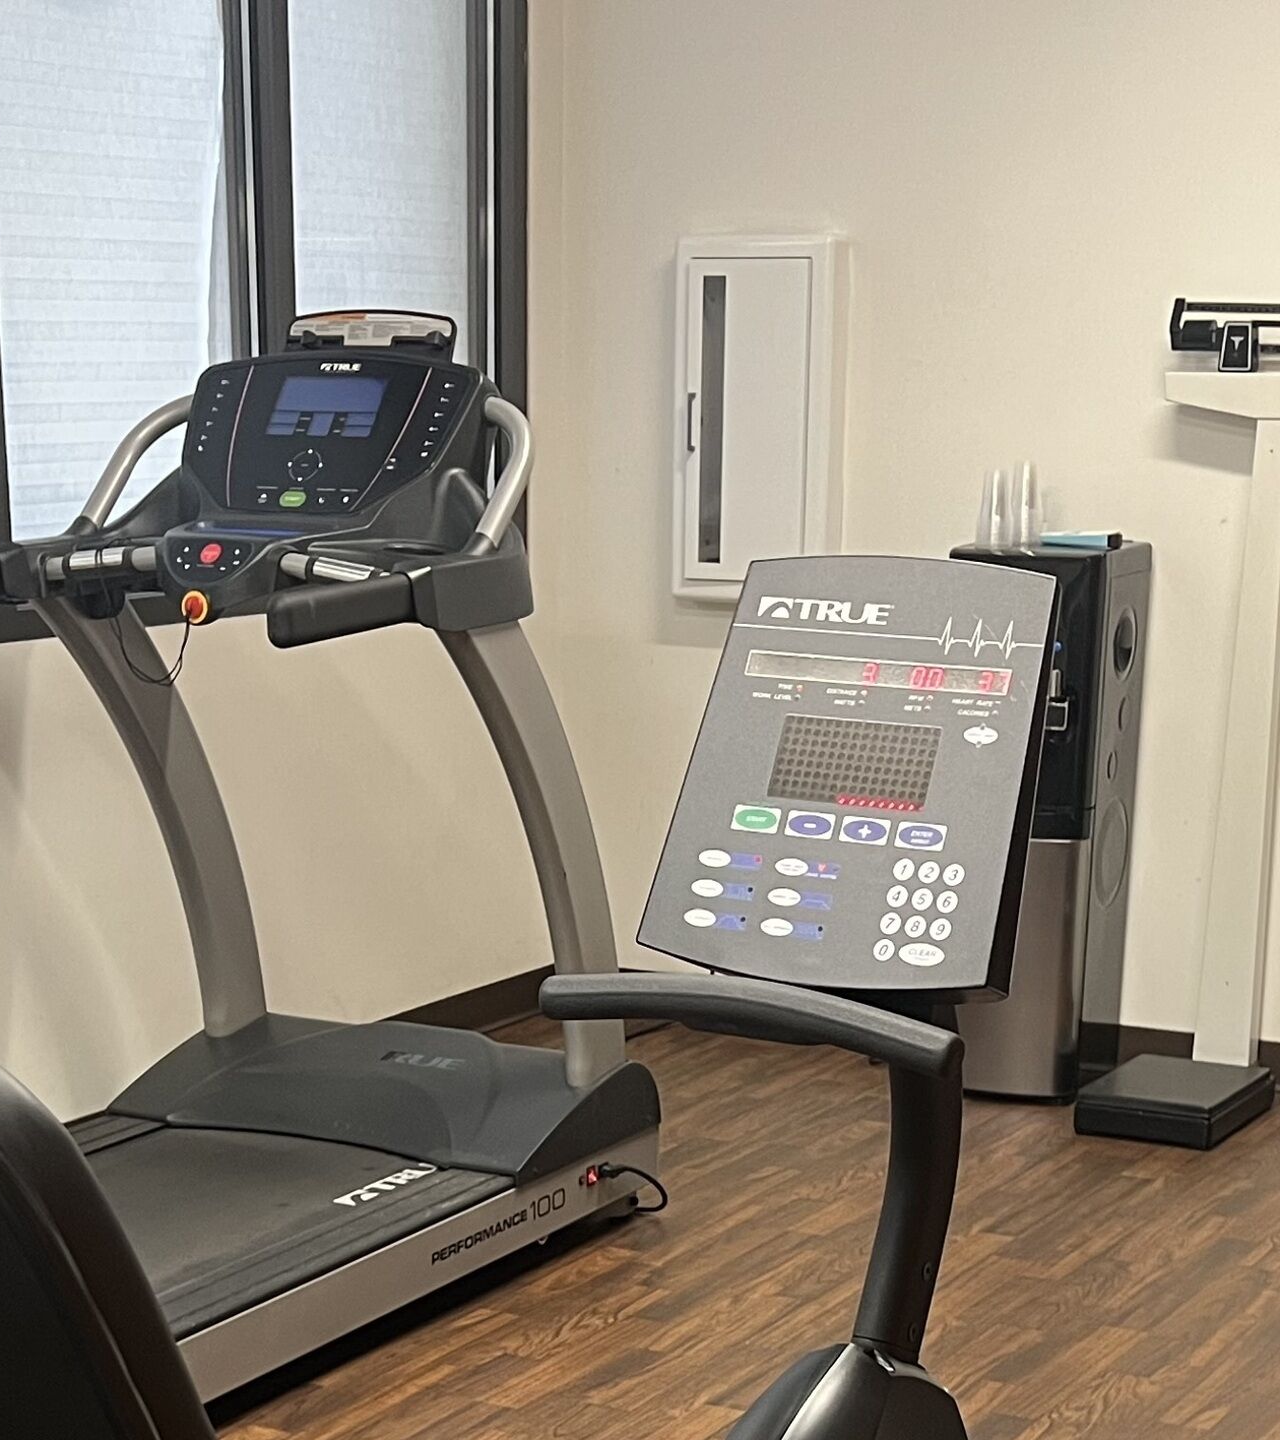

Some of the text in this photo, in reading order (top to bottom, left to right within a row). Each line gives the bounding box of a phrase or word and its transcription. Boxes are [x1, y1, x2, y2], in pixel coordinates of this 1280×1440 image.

[794, 598, 891, 626] TRUE
[924, 866, 935, 879] 2
[948, 869, 959, 881] 3
[892, 890, 952, 908] 4 5 6
[885, 917, 946, 936] 7 8 9
[878, 944, 937, 957] 0 CLEAR
[431, 1187, 566, 1266] PERFORMANCE 100
